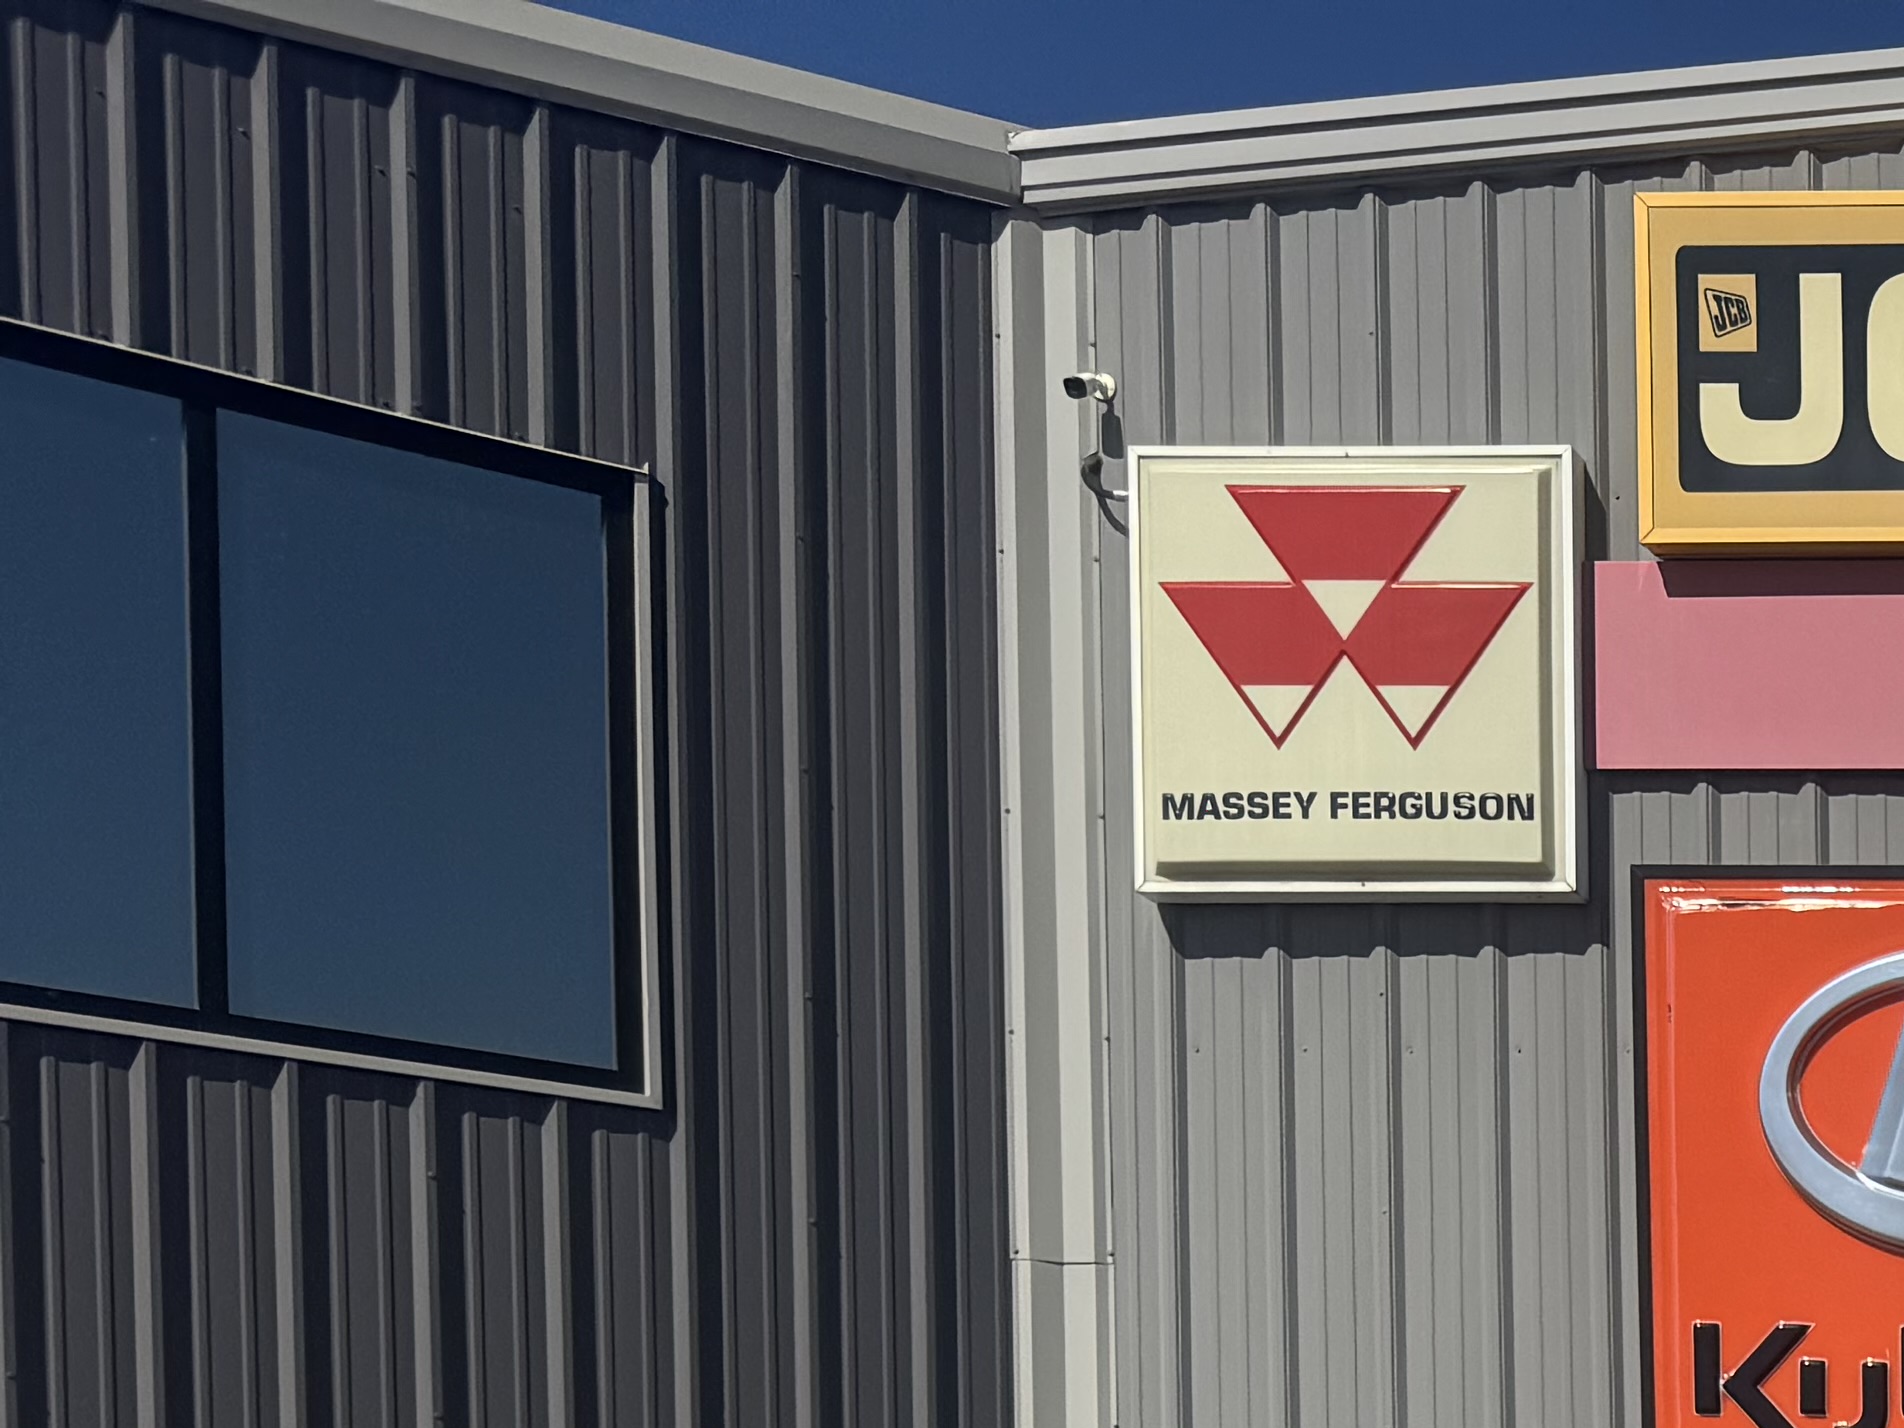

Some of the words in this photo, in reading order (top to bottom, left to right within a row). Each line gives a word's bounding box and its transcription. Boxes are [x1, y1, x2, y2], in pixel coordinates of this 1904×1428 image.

[1711, 293, 1749, 333] JCB
[1161, 791, 1318, 821] MASSEY
[1329, 791, 1536, 822] FERGUSON
